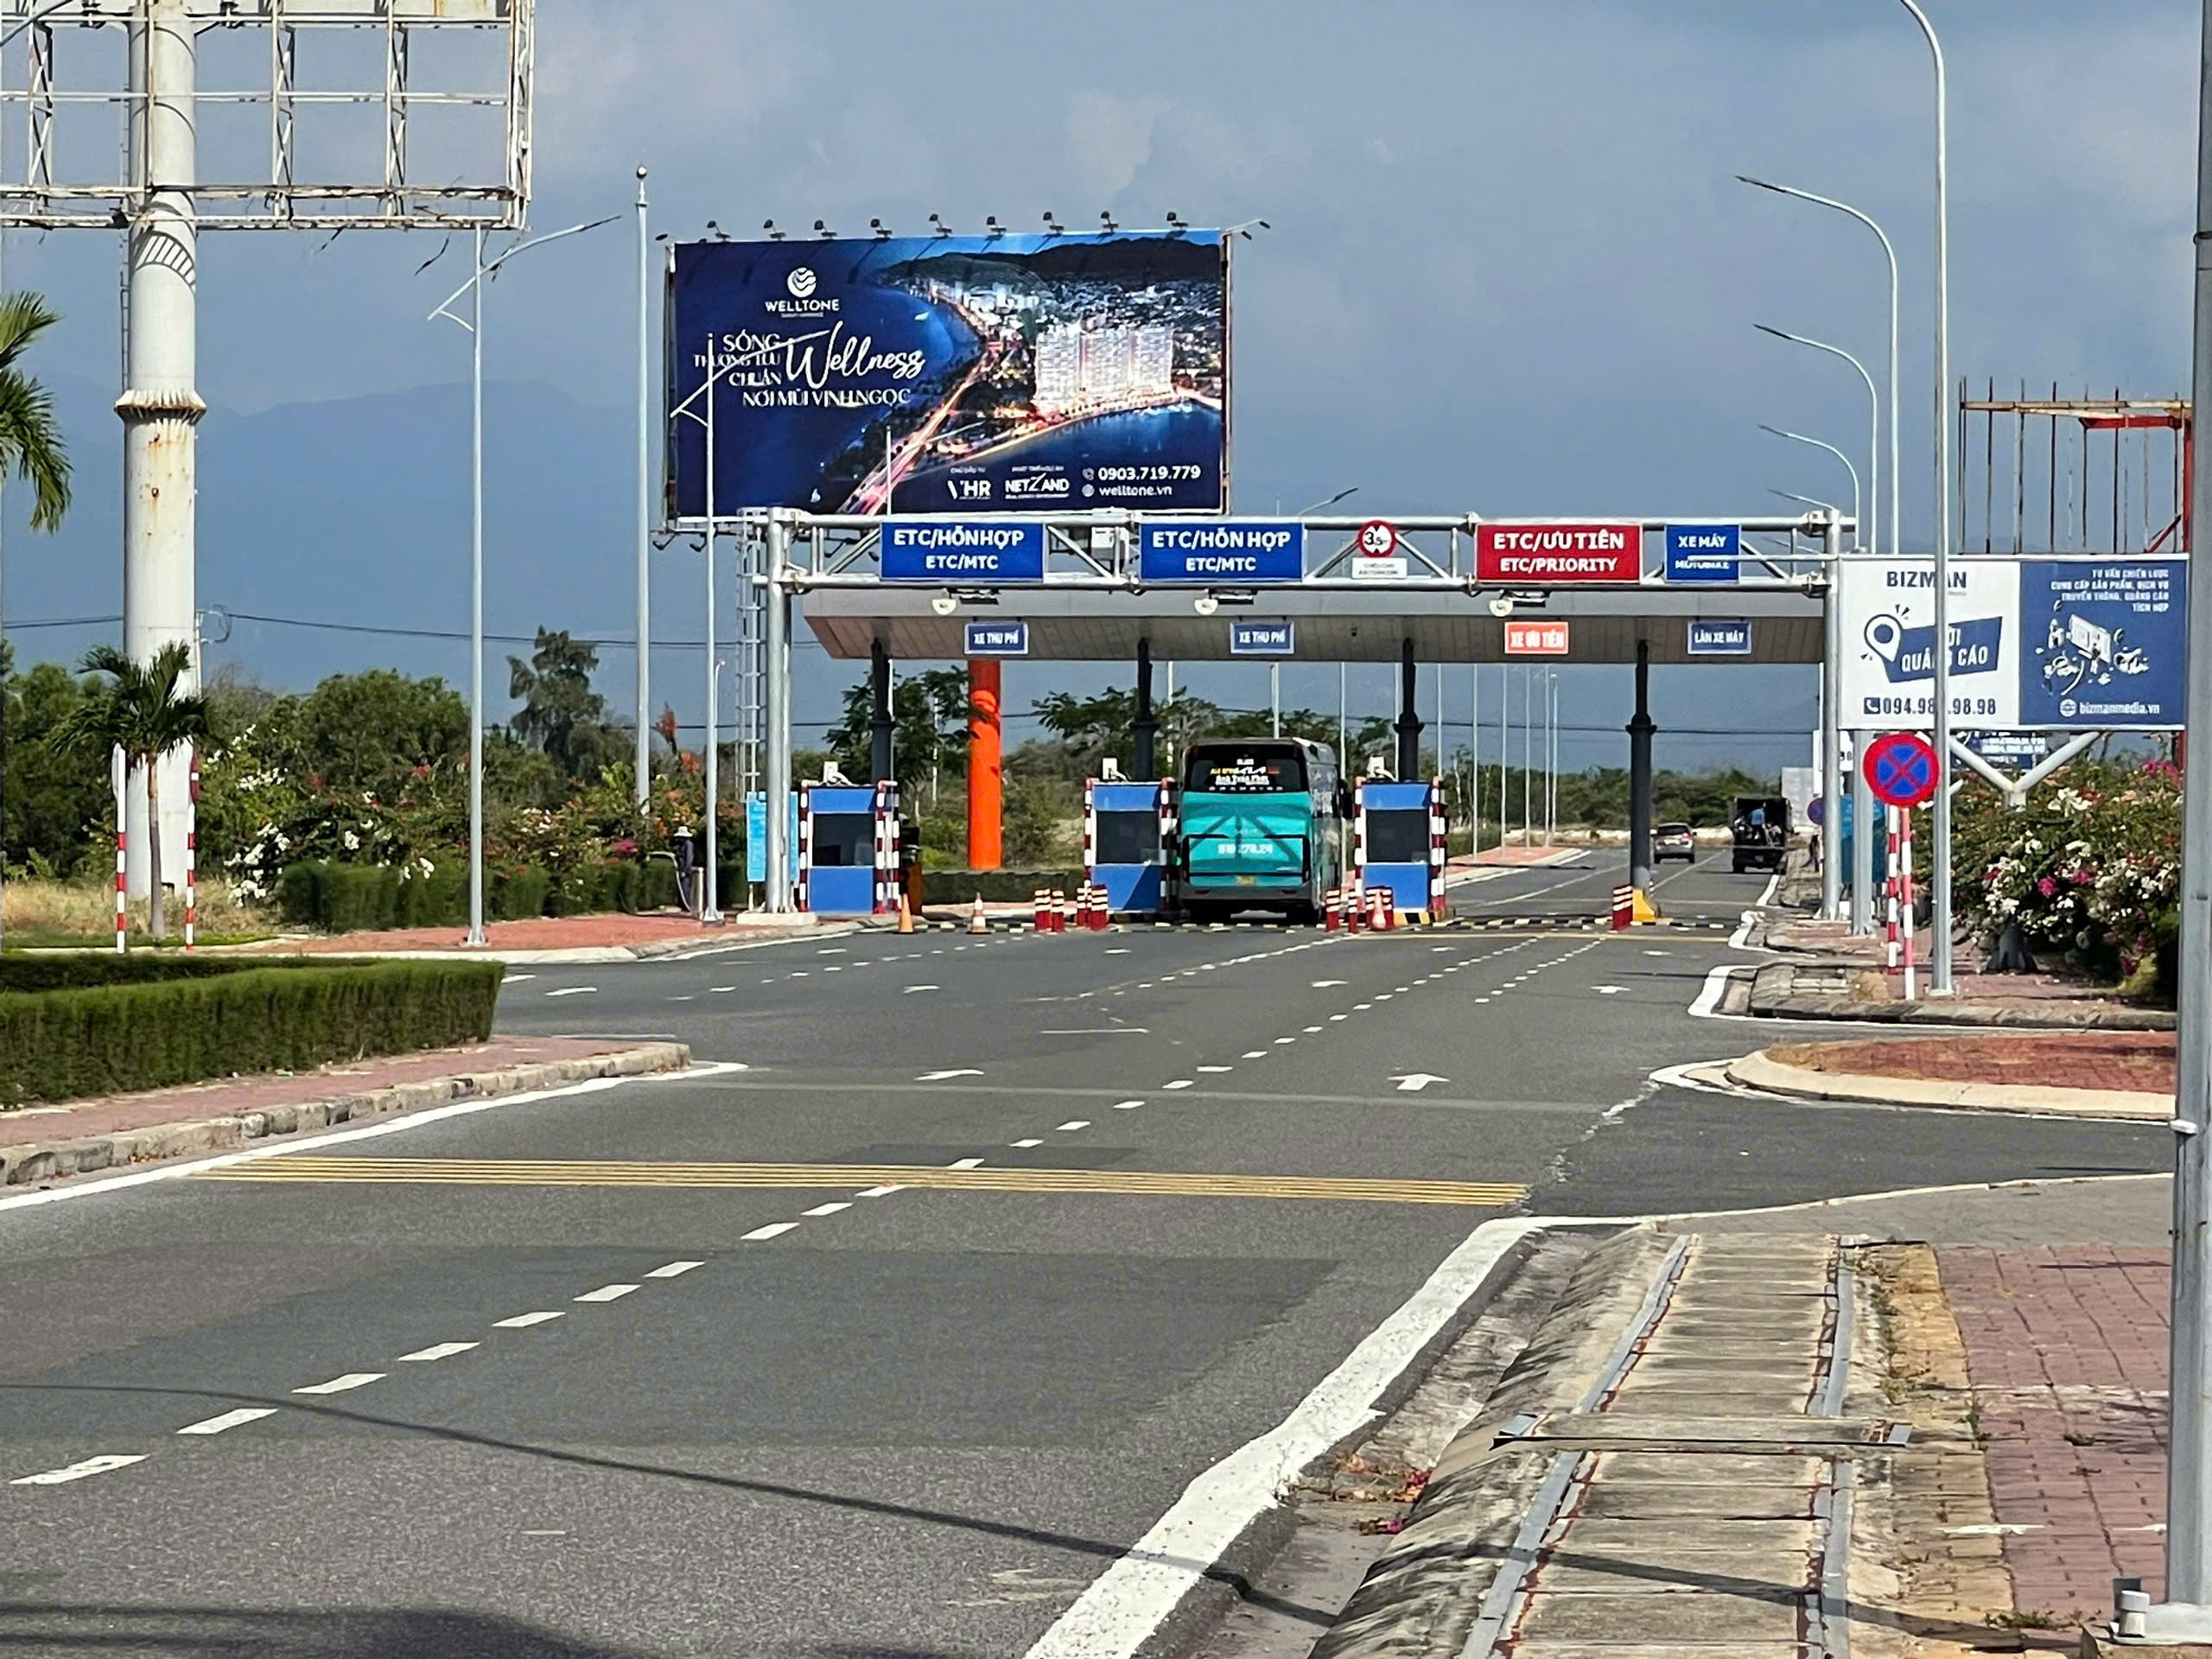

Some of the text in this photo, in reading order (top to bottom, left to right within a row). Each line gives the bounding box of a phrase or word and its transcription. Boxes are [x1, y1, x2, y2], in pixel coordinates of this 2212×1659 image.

[765, 299, 840, 312] WELLTONE
[785, 321, 926, 389] Wellness
[1098, 465, 1201, 480] 0903.719.779
[1099, 485, 1173, 496] welltone.vn
[1574, 528, 1624, 550] TIÊN
[1678, 532, 1726, 548] XE MÁY
[925, 554, 999, 569] ETC/MTC
[1185, 556, 1256, 573] ETC/MTC
[1500, 556, 1618, 575] ETC/PRIORITY
[1713, 632, 1725, 644] XE
[1957, 644, 1988, 667] CÁO
[1883, 697, 1996, 715] 094.98.98.98
